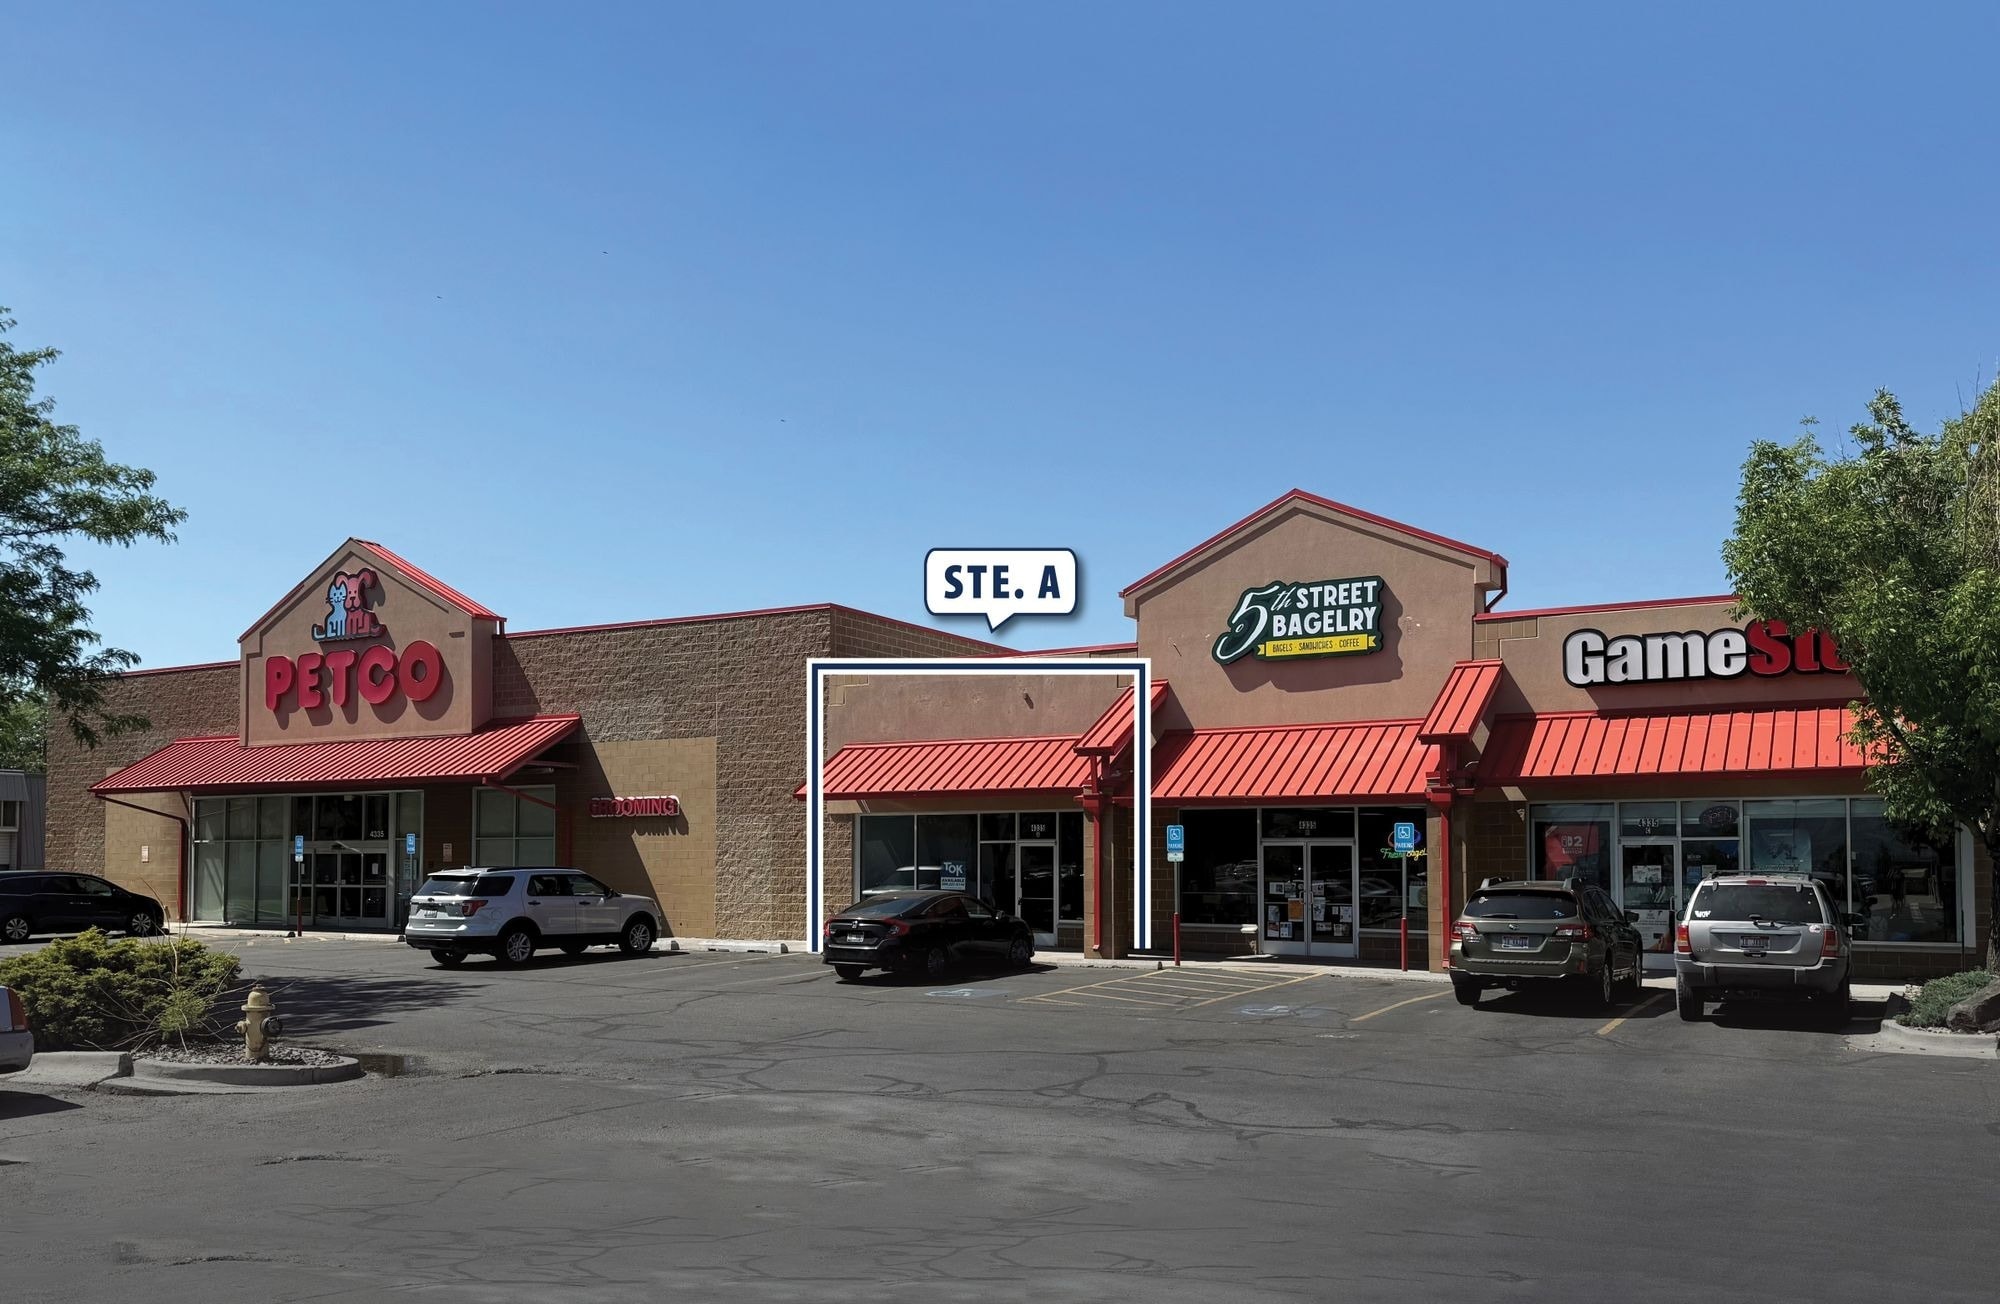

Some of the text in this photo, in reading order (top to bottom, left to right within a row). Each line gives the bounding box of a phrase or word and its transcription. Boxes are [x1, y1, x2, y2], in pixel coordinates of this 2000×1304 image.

[1216, 581, 1378, 660] 5th STREET
[1273, 606, 1377, 637] BAGELRY
[1272, 637, 1360, 652] BAGELS SANDWICHES COFFEE
[265, 640, 443, 711] PETCO
[591, 797, 677, 816] GROOMING
